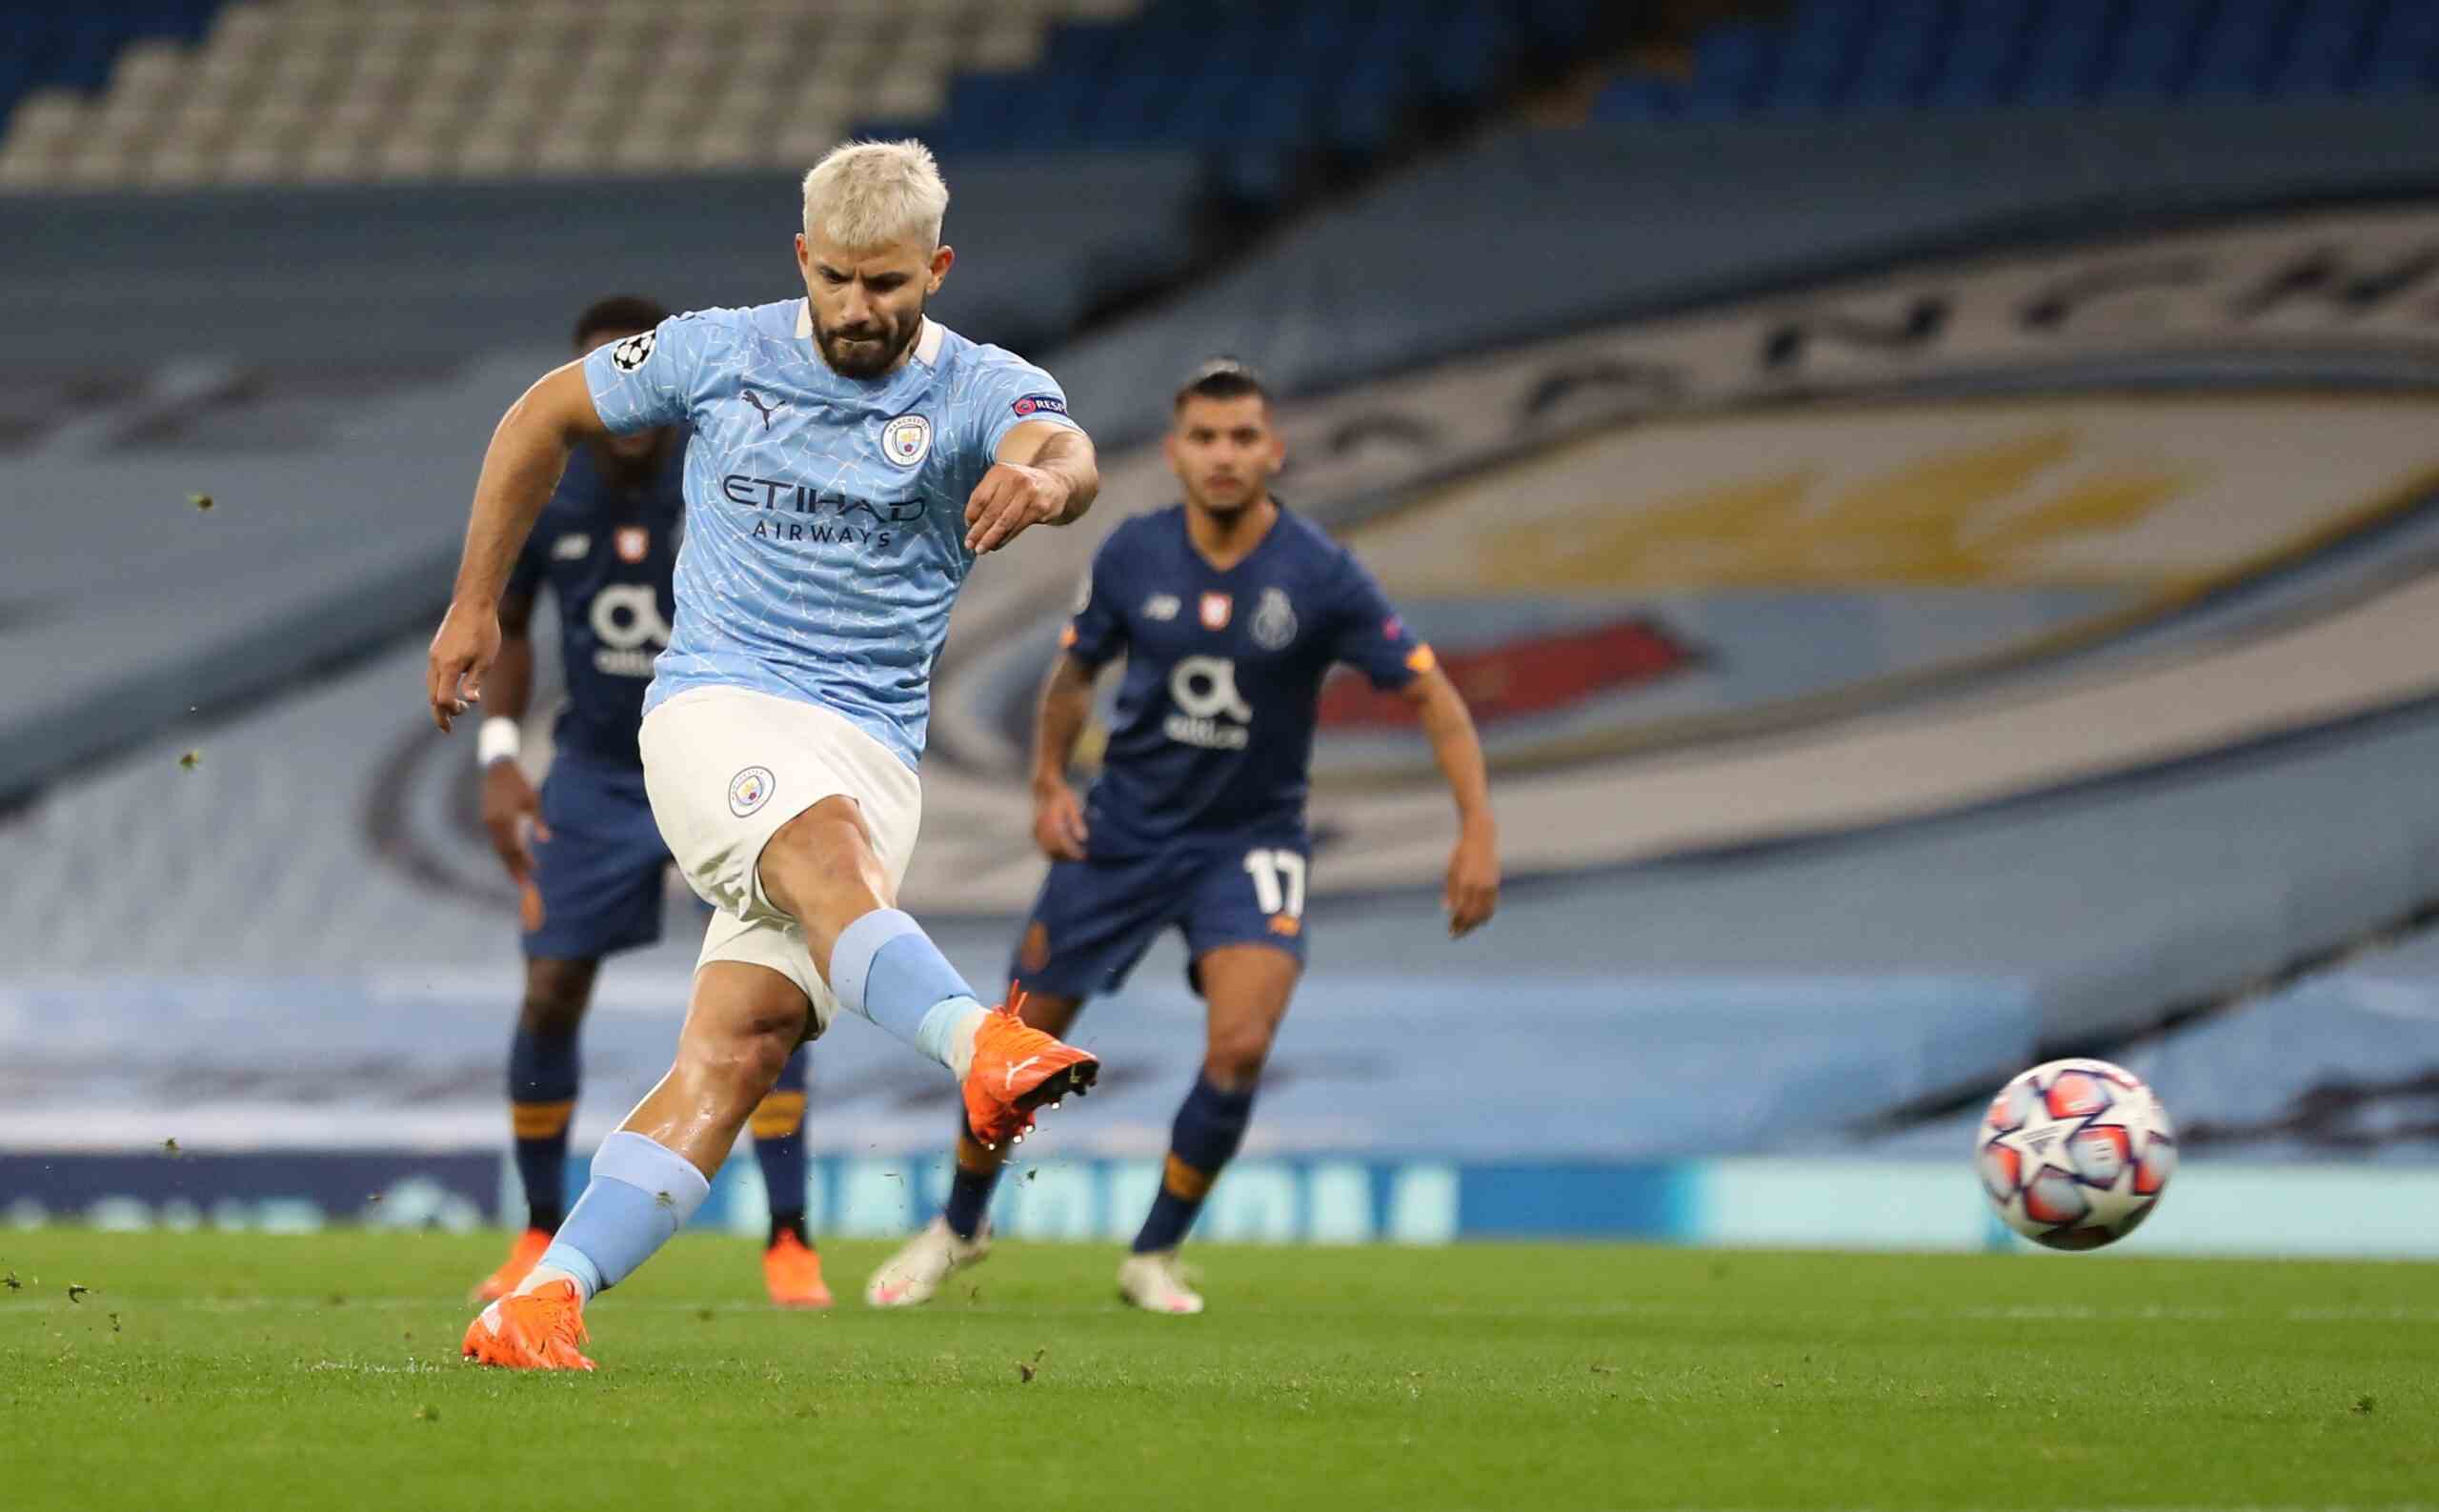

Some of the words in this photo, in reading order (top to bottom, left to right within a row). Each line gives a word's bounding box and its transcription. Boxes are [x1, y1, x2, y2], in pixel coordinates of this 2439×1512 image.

[723, 474, 926, 523] ETIHAD
[752, 521, 892, 548] AIRWAYS
[1242, 847, 1305, 918] 17
